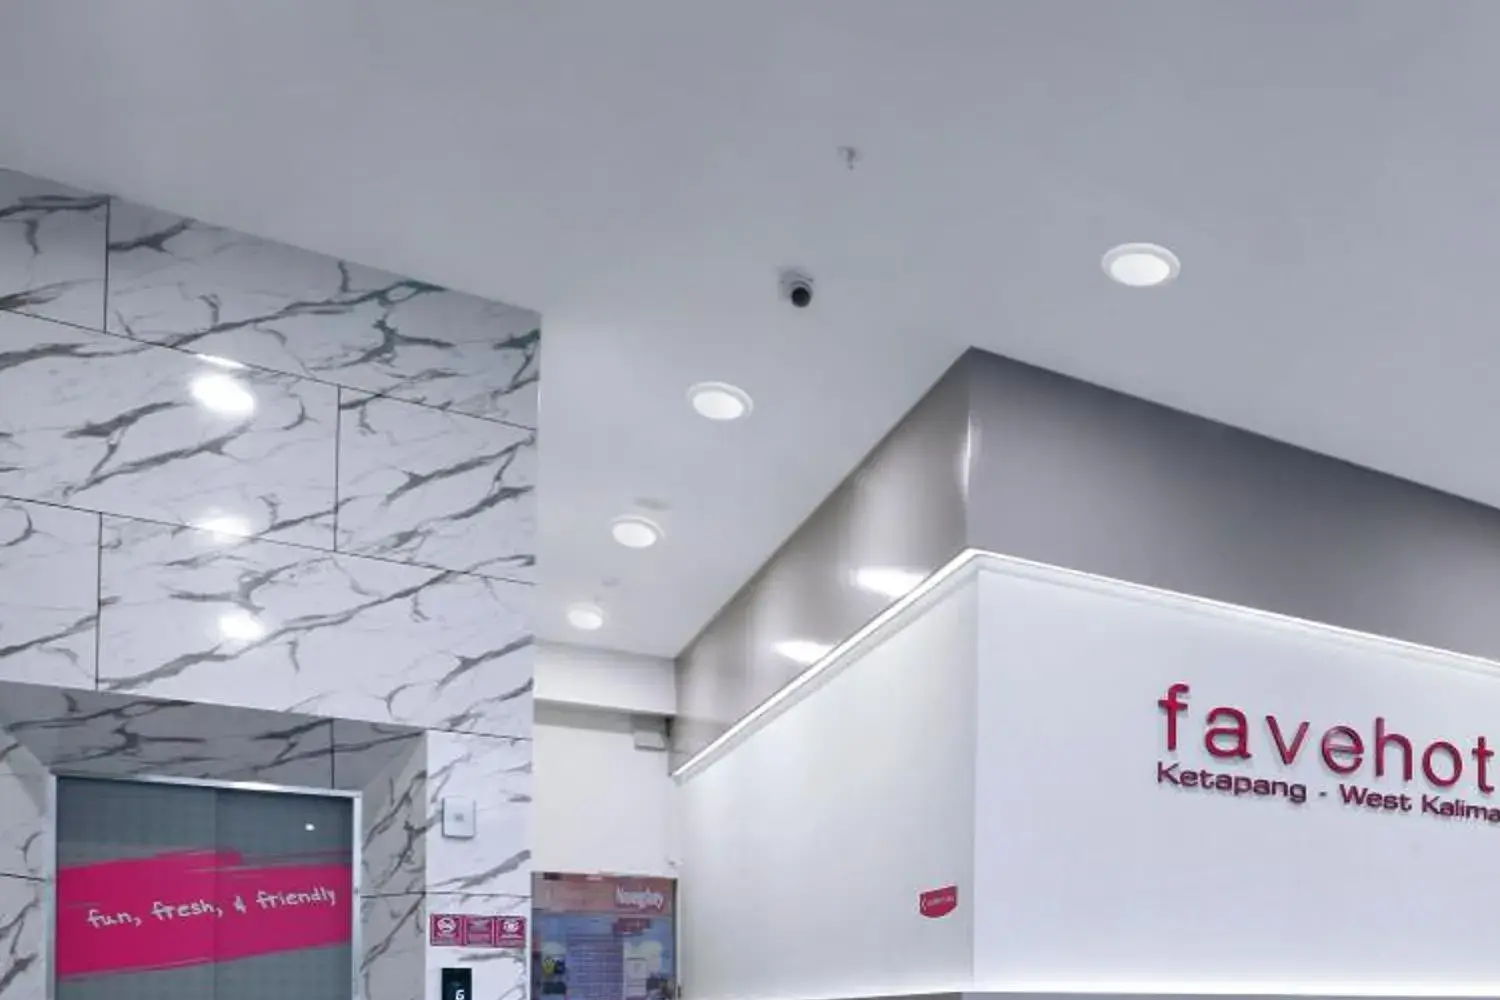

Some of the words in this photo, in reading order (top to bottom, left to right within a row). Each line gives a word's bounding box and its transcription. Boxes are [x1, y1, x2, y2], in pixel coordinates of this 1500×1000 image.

[1156, 761, 1307, 804] Ketapang
[1339, 784, 1412, 812] West
[87, 909, 142, 929] fun,
[151, 899, 223, 921] fresh,
[256, 886, 337, 910] friendly
